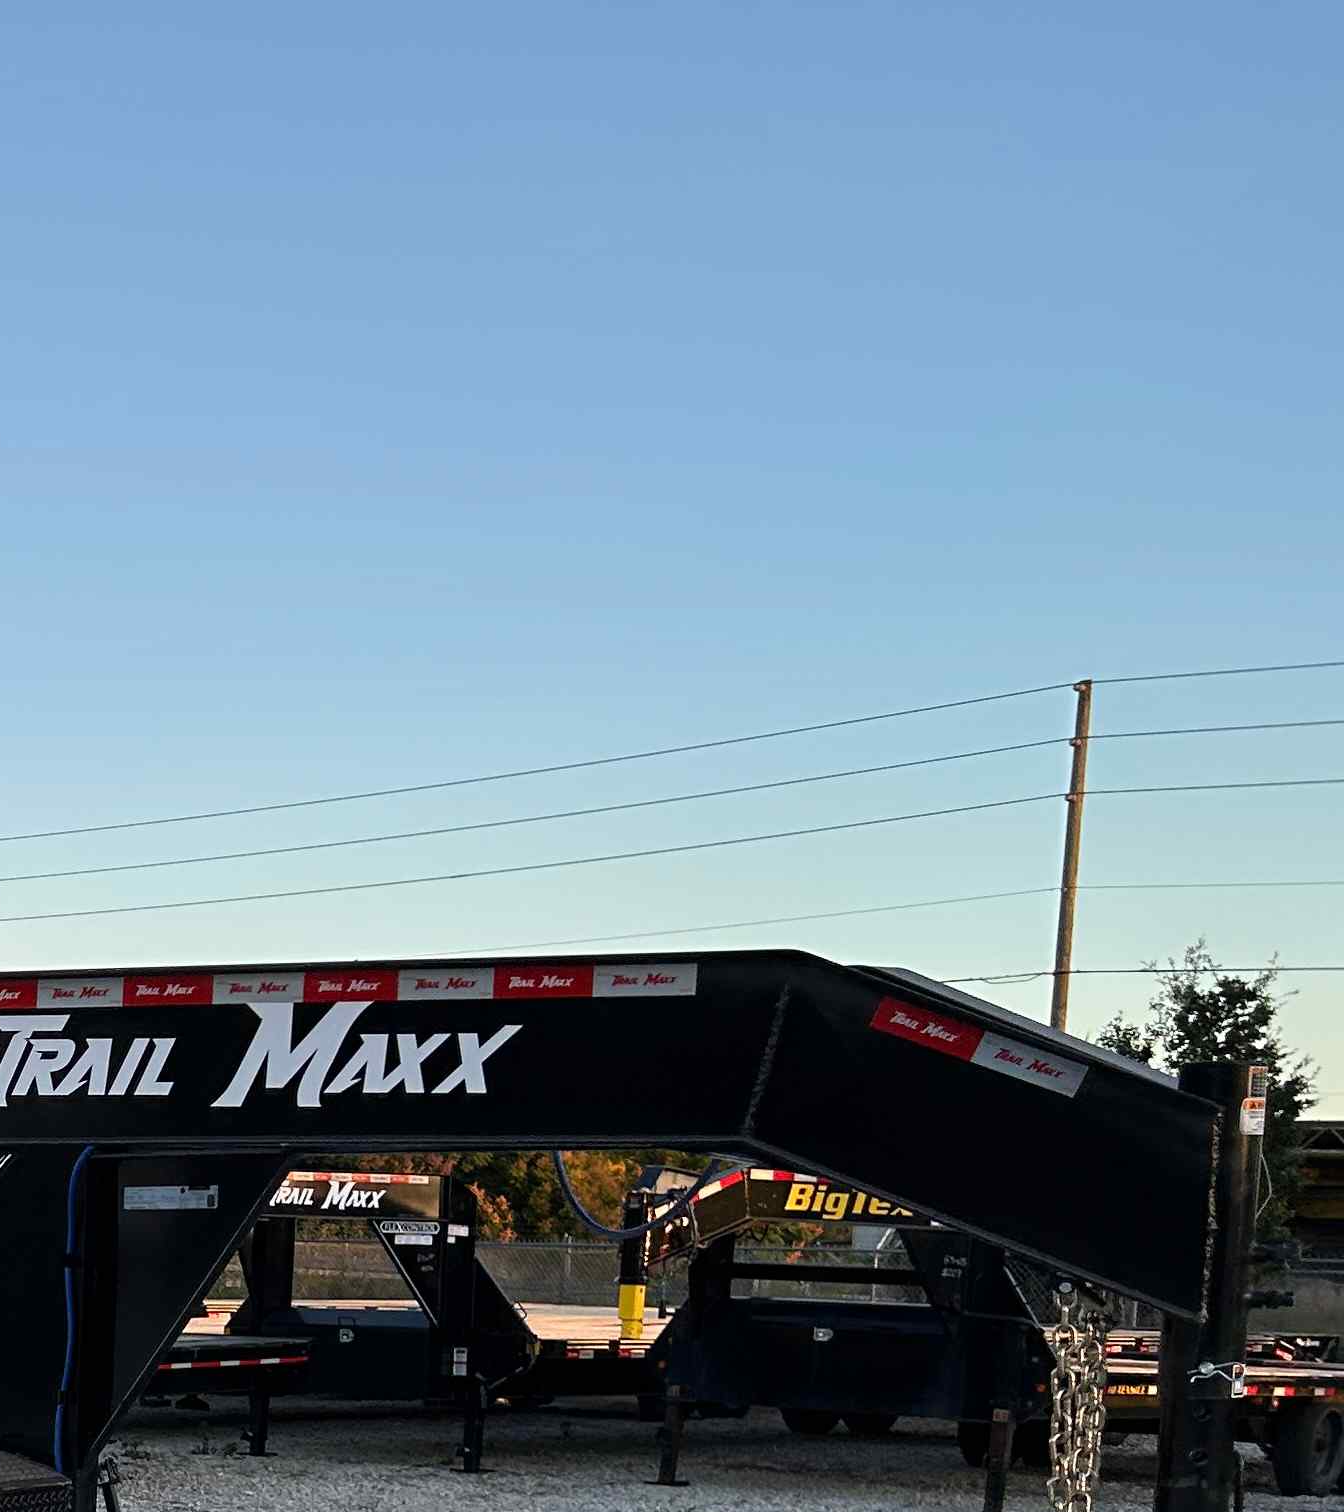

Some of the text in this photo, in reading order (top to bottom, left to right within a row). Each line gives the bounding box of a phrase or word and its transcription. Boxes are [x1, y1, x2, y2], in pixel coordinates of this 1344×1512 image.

[317, 979, 381, 993] TRAIL MAXX
[508, 975, 574, 989] TRAIL MAXX
[136, 983, 197, 996] TRAIL MAXX
[210, 1000, 524, 1107] MAXX
[321, 1181, 386, 1210] MAXX
